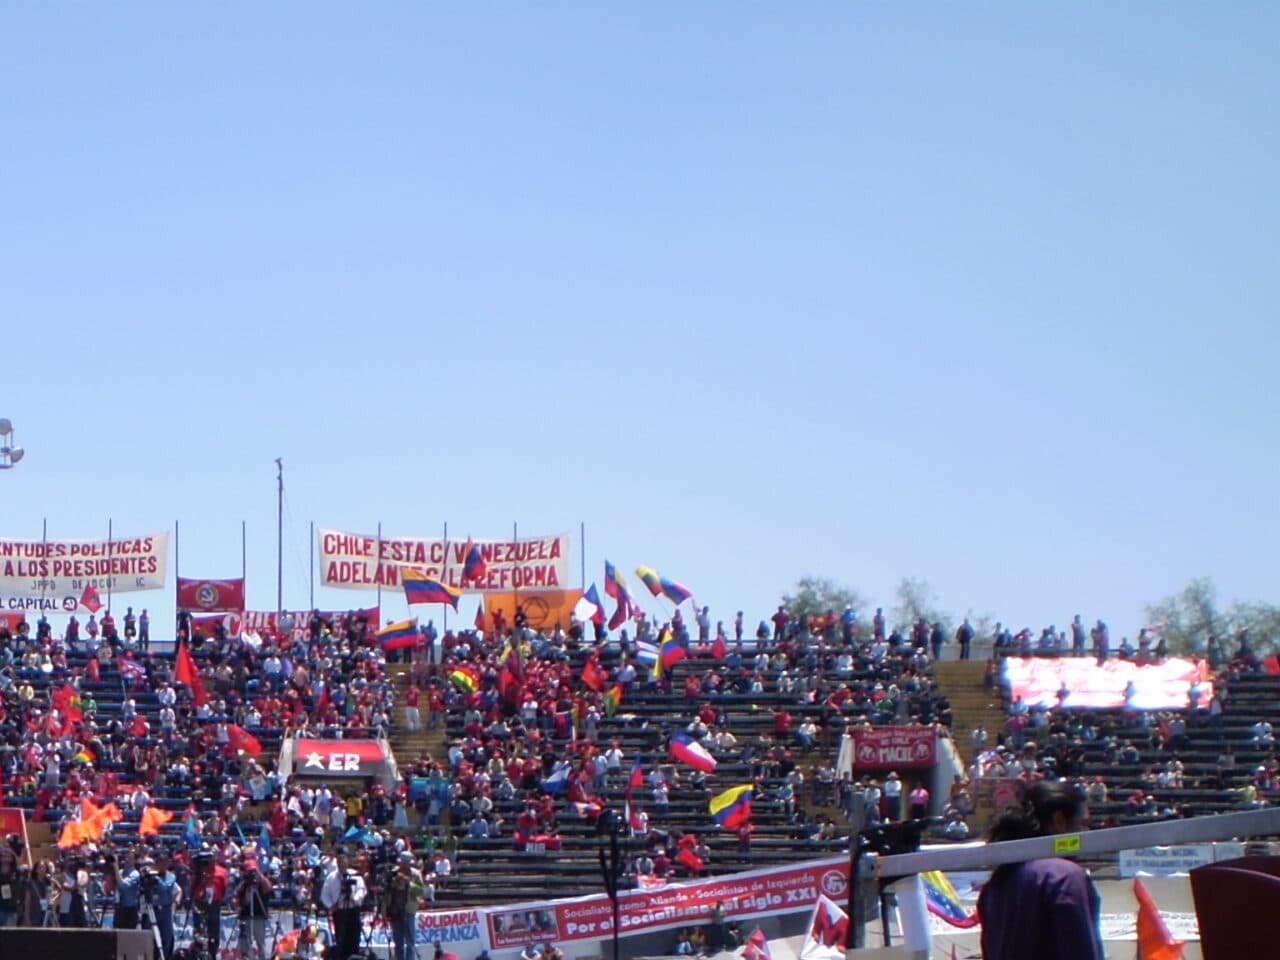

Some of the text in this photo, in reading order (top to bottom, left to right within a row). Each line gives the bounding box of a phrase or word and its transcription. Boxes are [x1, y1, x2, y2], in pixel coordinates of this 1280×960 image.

[70, 537, 153, 557] POLITICAS
[323, 533, 375, 555] CHILE
[378, 540, 428, 563] ESTA
[454, 538, 561, 563] VNEZUELA
[4, 560, 15, 577] A
[18, 560, 49, 577] LOS
[53, 556, 157, 577] PRESIDENTES
[326, 561, 422, 586] ADELAN
[13, 597, 59, 611] CAPITAL
[752, 881, 764, 891] de
[418, 911, 480, 929] SOLIDARIA
[567, 922, 597, 935] Por
[621, 904, 709, 927] Socialismo
[742, 891, 783, 910] siglo
[785, 886, 818, 902] XXI
[415, 924, 480, 943] ESPERANZA
